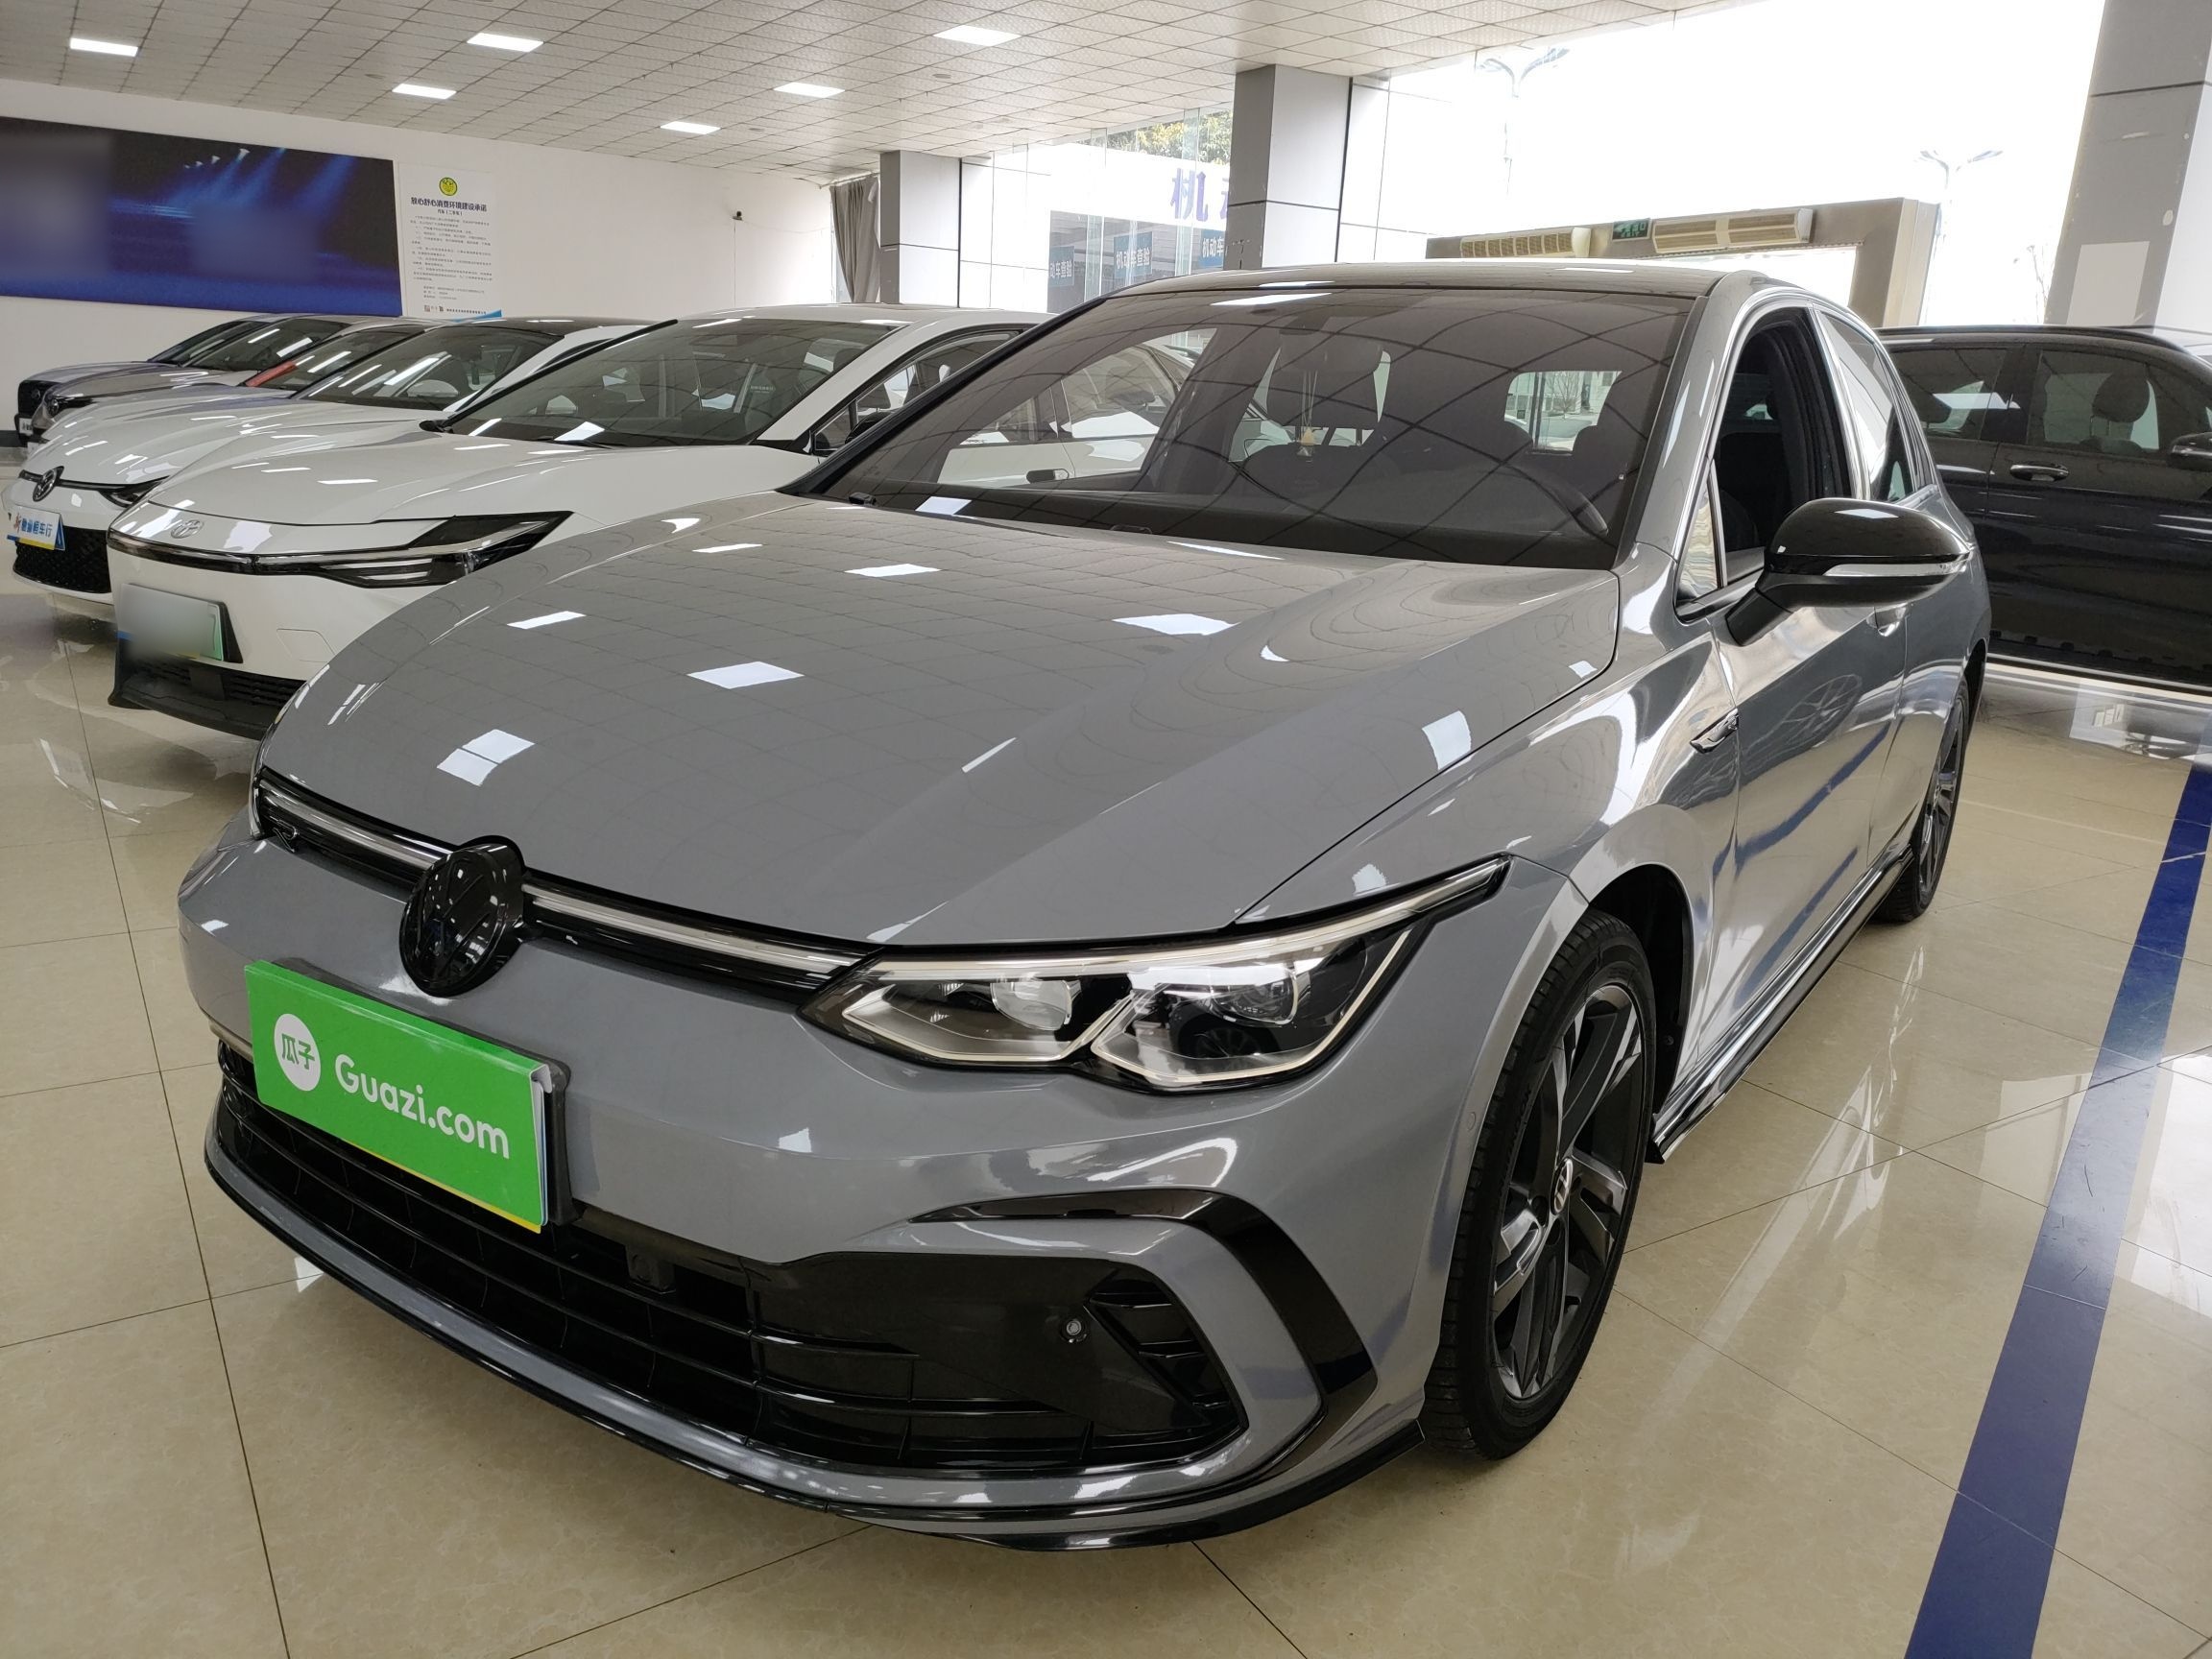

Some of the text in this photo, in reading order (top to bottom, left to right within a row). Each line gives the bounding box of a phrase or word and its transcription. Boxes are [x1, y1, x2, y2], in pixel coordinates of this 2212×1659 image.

[1116, 248, 1150, 269] 机动车查验
[281, 1033, 315, 1070] 瓜子
[335, 1053, 510, 1159] Guazi.com
